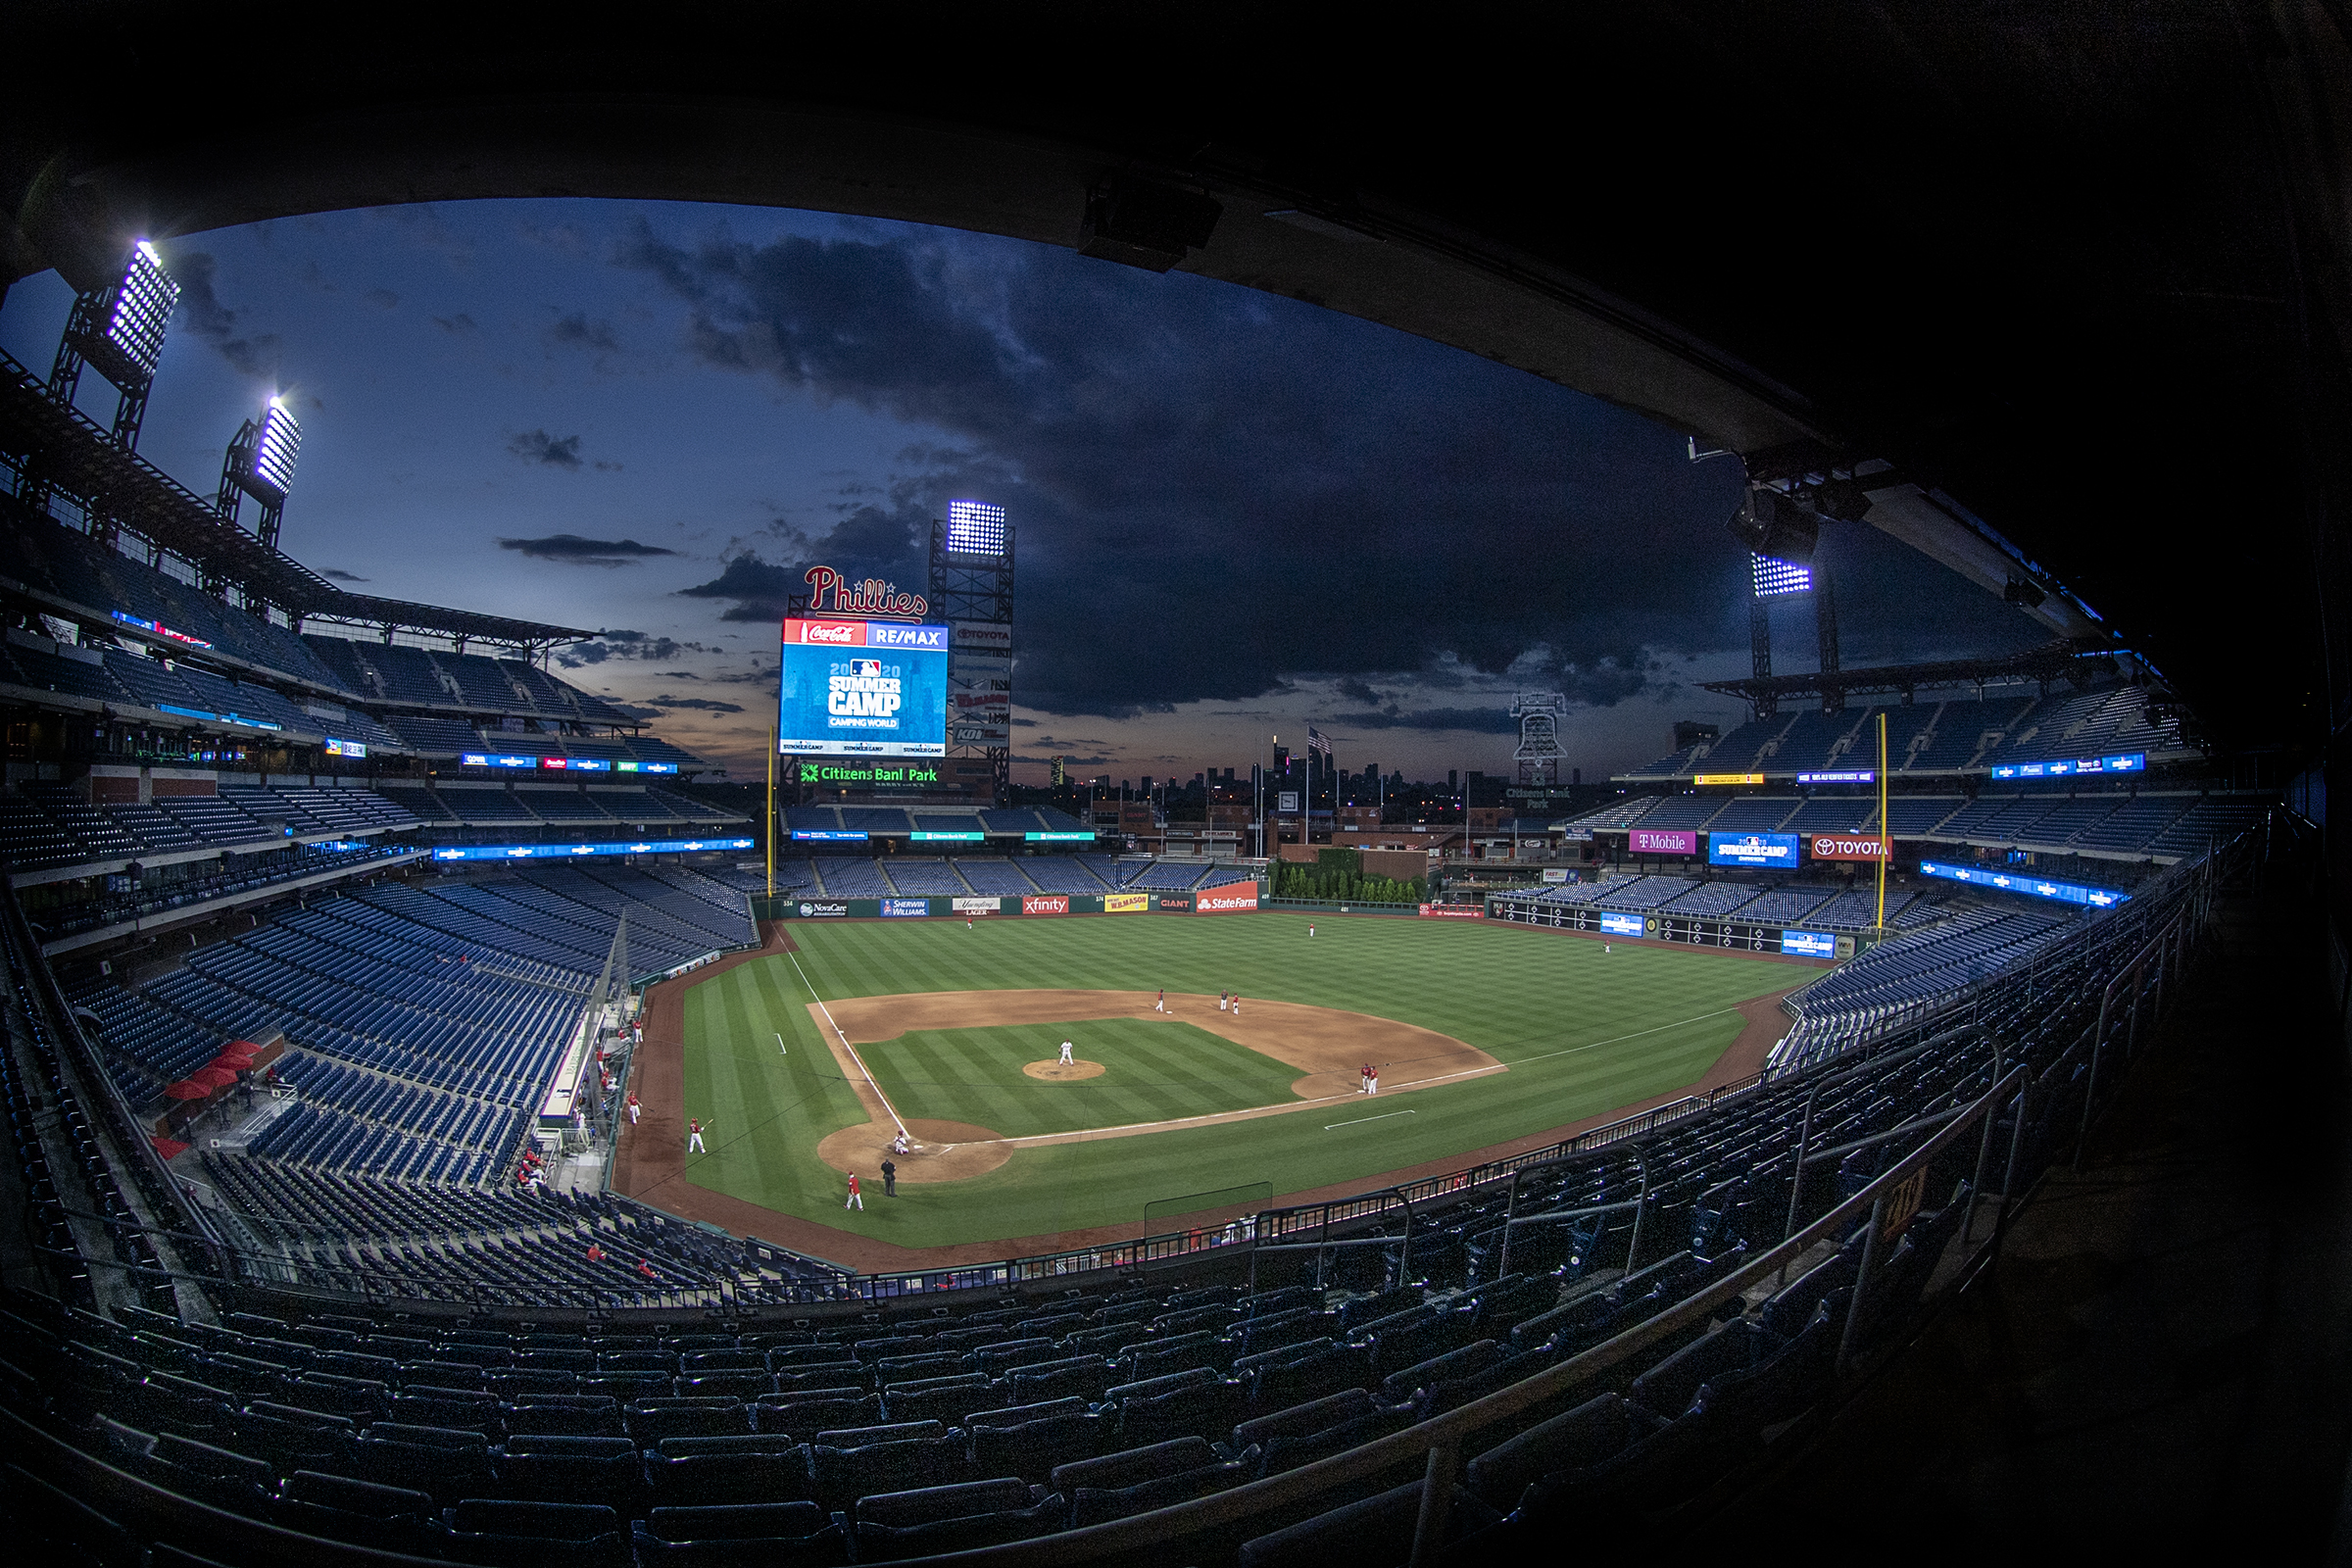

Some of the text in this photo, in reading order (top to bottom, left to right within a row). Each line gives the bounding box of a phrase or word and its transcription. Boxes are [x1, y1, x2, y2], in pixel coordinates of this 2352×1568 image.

[805, 565, 928, 615] Phillies
[809, 625, 856, 642] Coca-Cola
[876, 629, 941, 646] RE/MAX
[971, 629, 1009, 640] TOYOTA
[830, 662, 901, 677] 20 20
[828, 676, 902, 693] SUMMER
[828, 692, 901, 716] CAMP
[829, 717, 868, 726] CAMPING
[820, 766, 873, 780] Citizens
[908, 768, 938, 782] Park
[1649, 835, 1686, 850] Mobile
[1837, 841, 1888, 856] TOYOTA
[1718, 844, 1788, 857] SUMMER CAMP
[813, 904, 848, 912] NovaCare
[893, 900, 926, 908] SHERWIN
[958, 898, 995, 908] Yuengling
[1025, 899, 1065, 913] xfinity
[1160, 900, 1190, 908] GIANT
